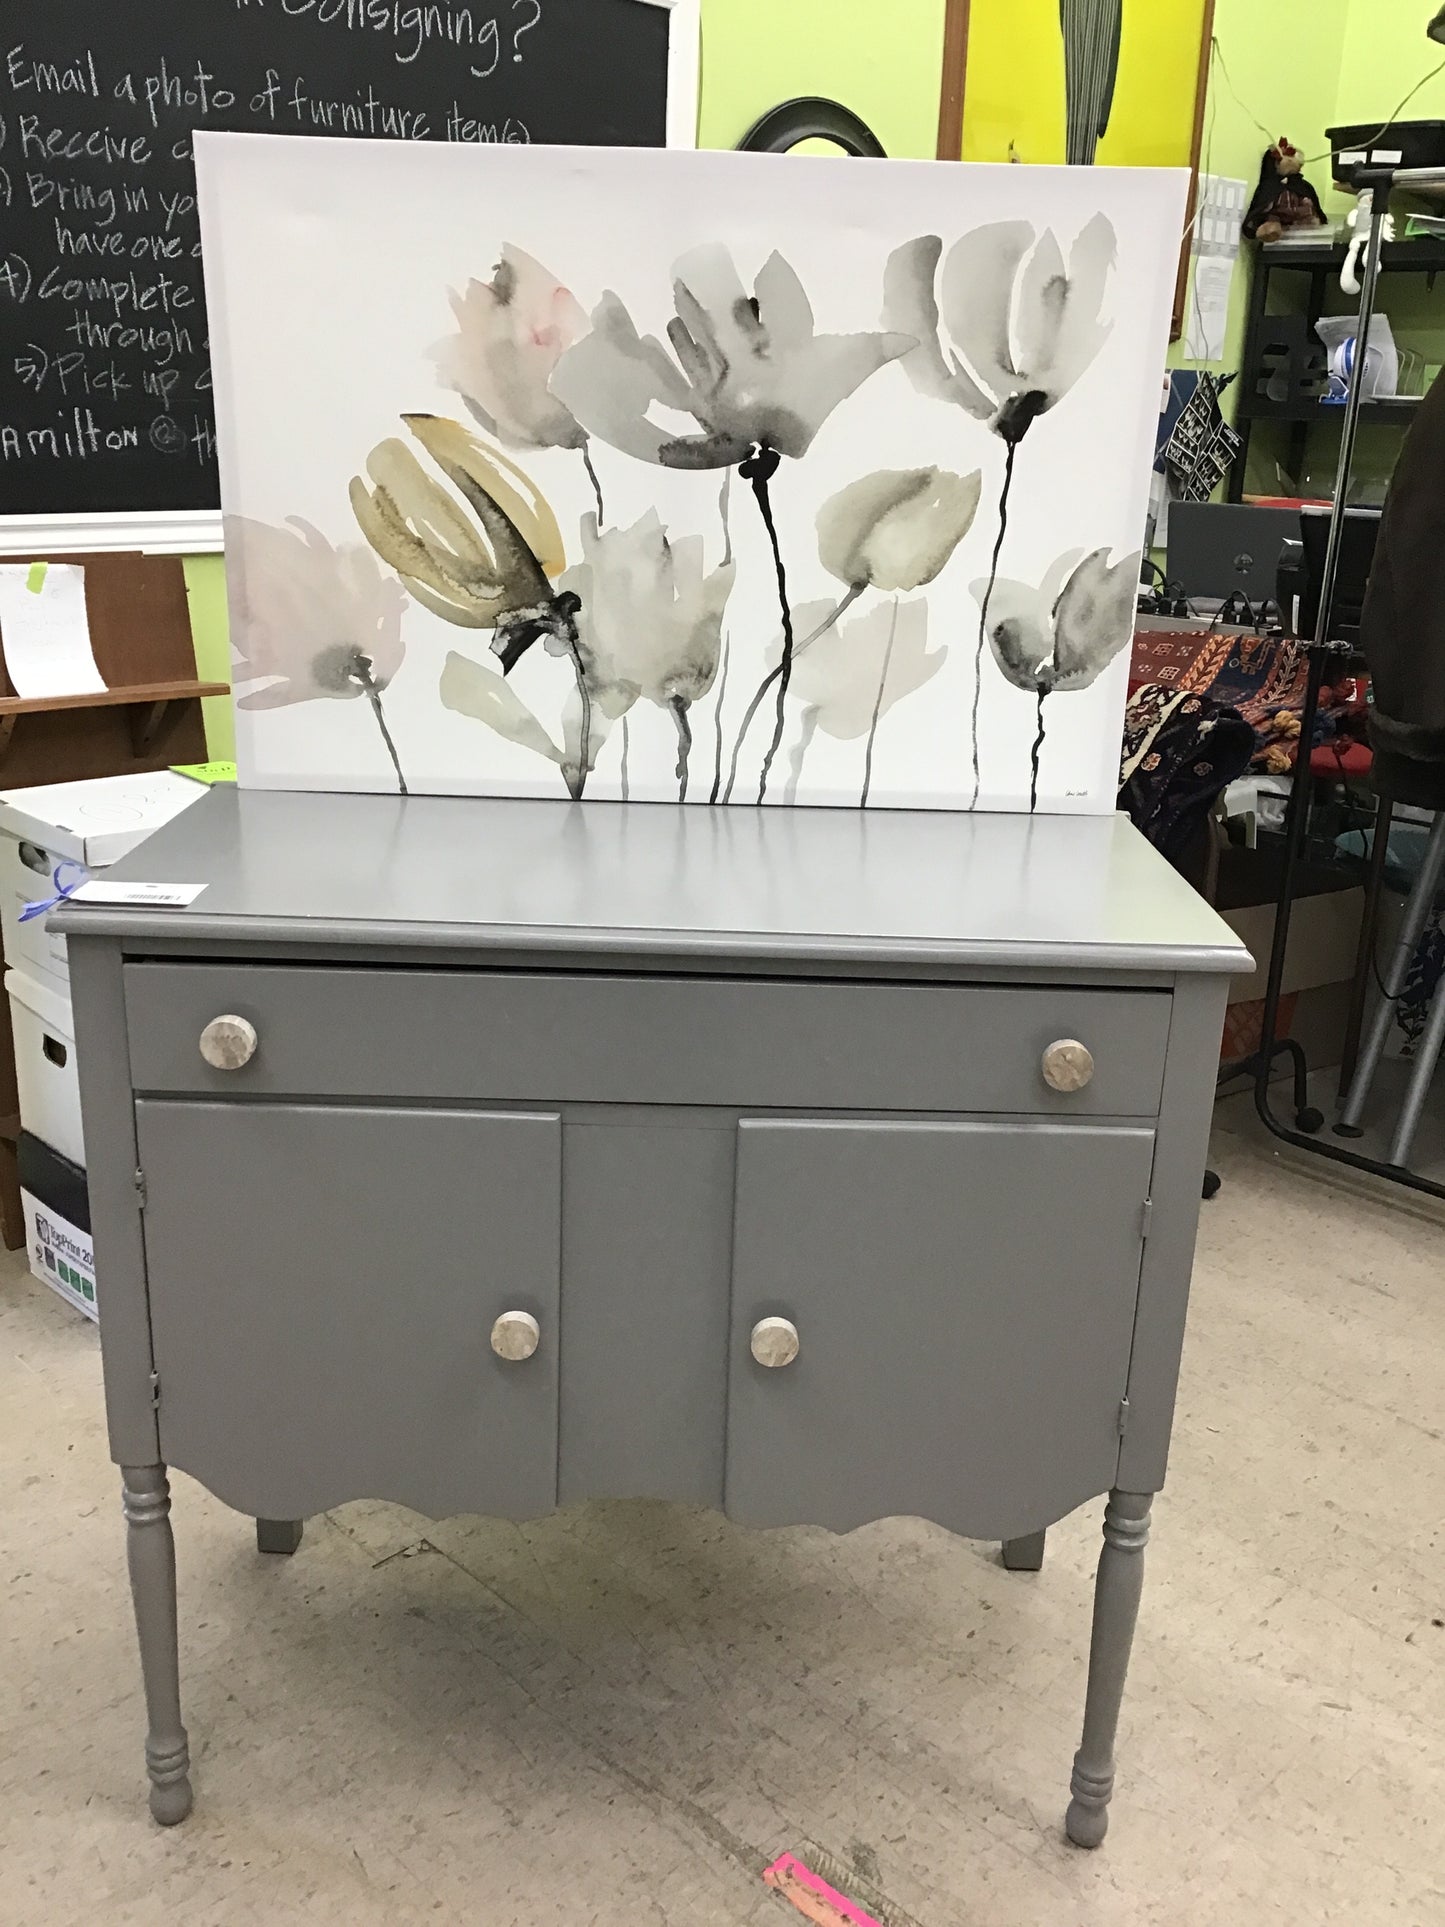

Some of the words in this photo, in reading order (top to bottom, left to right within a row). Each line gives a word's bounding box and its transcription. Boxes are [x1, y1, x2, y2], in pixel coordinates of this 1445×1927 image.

[281, 0, 541, 77] onsigning?
[6, 44, 99, 97] Email
[114, 73, 137, 104] a
[145, 55, 236, 128] photo
[249, 69, 281, 120] of
[288, 76, 430, 139] furniture
[20, 114, 152, 164] Receive
[26, 172, 116, 227] Bring
[123, 183, 149, 213] in
[158, 190, 201, 232] yo
[54, 217, 125, 256] have
[130, 232, 183, 261] one
[37, 266, 196, 318] Complete
[65, 308, 193, 366] through
[51, 351, 132, 402] Pick
[142, 368, 180, 412] up
